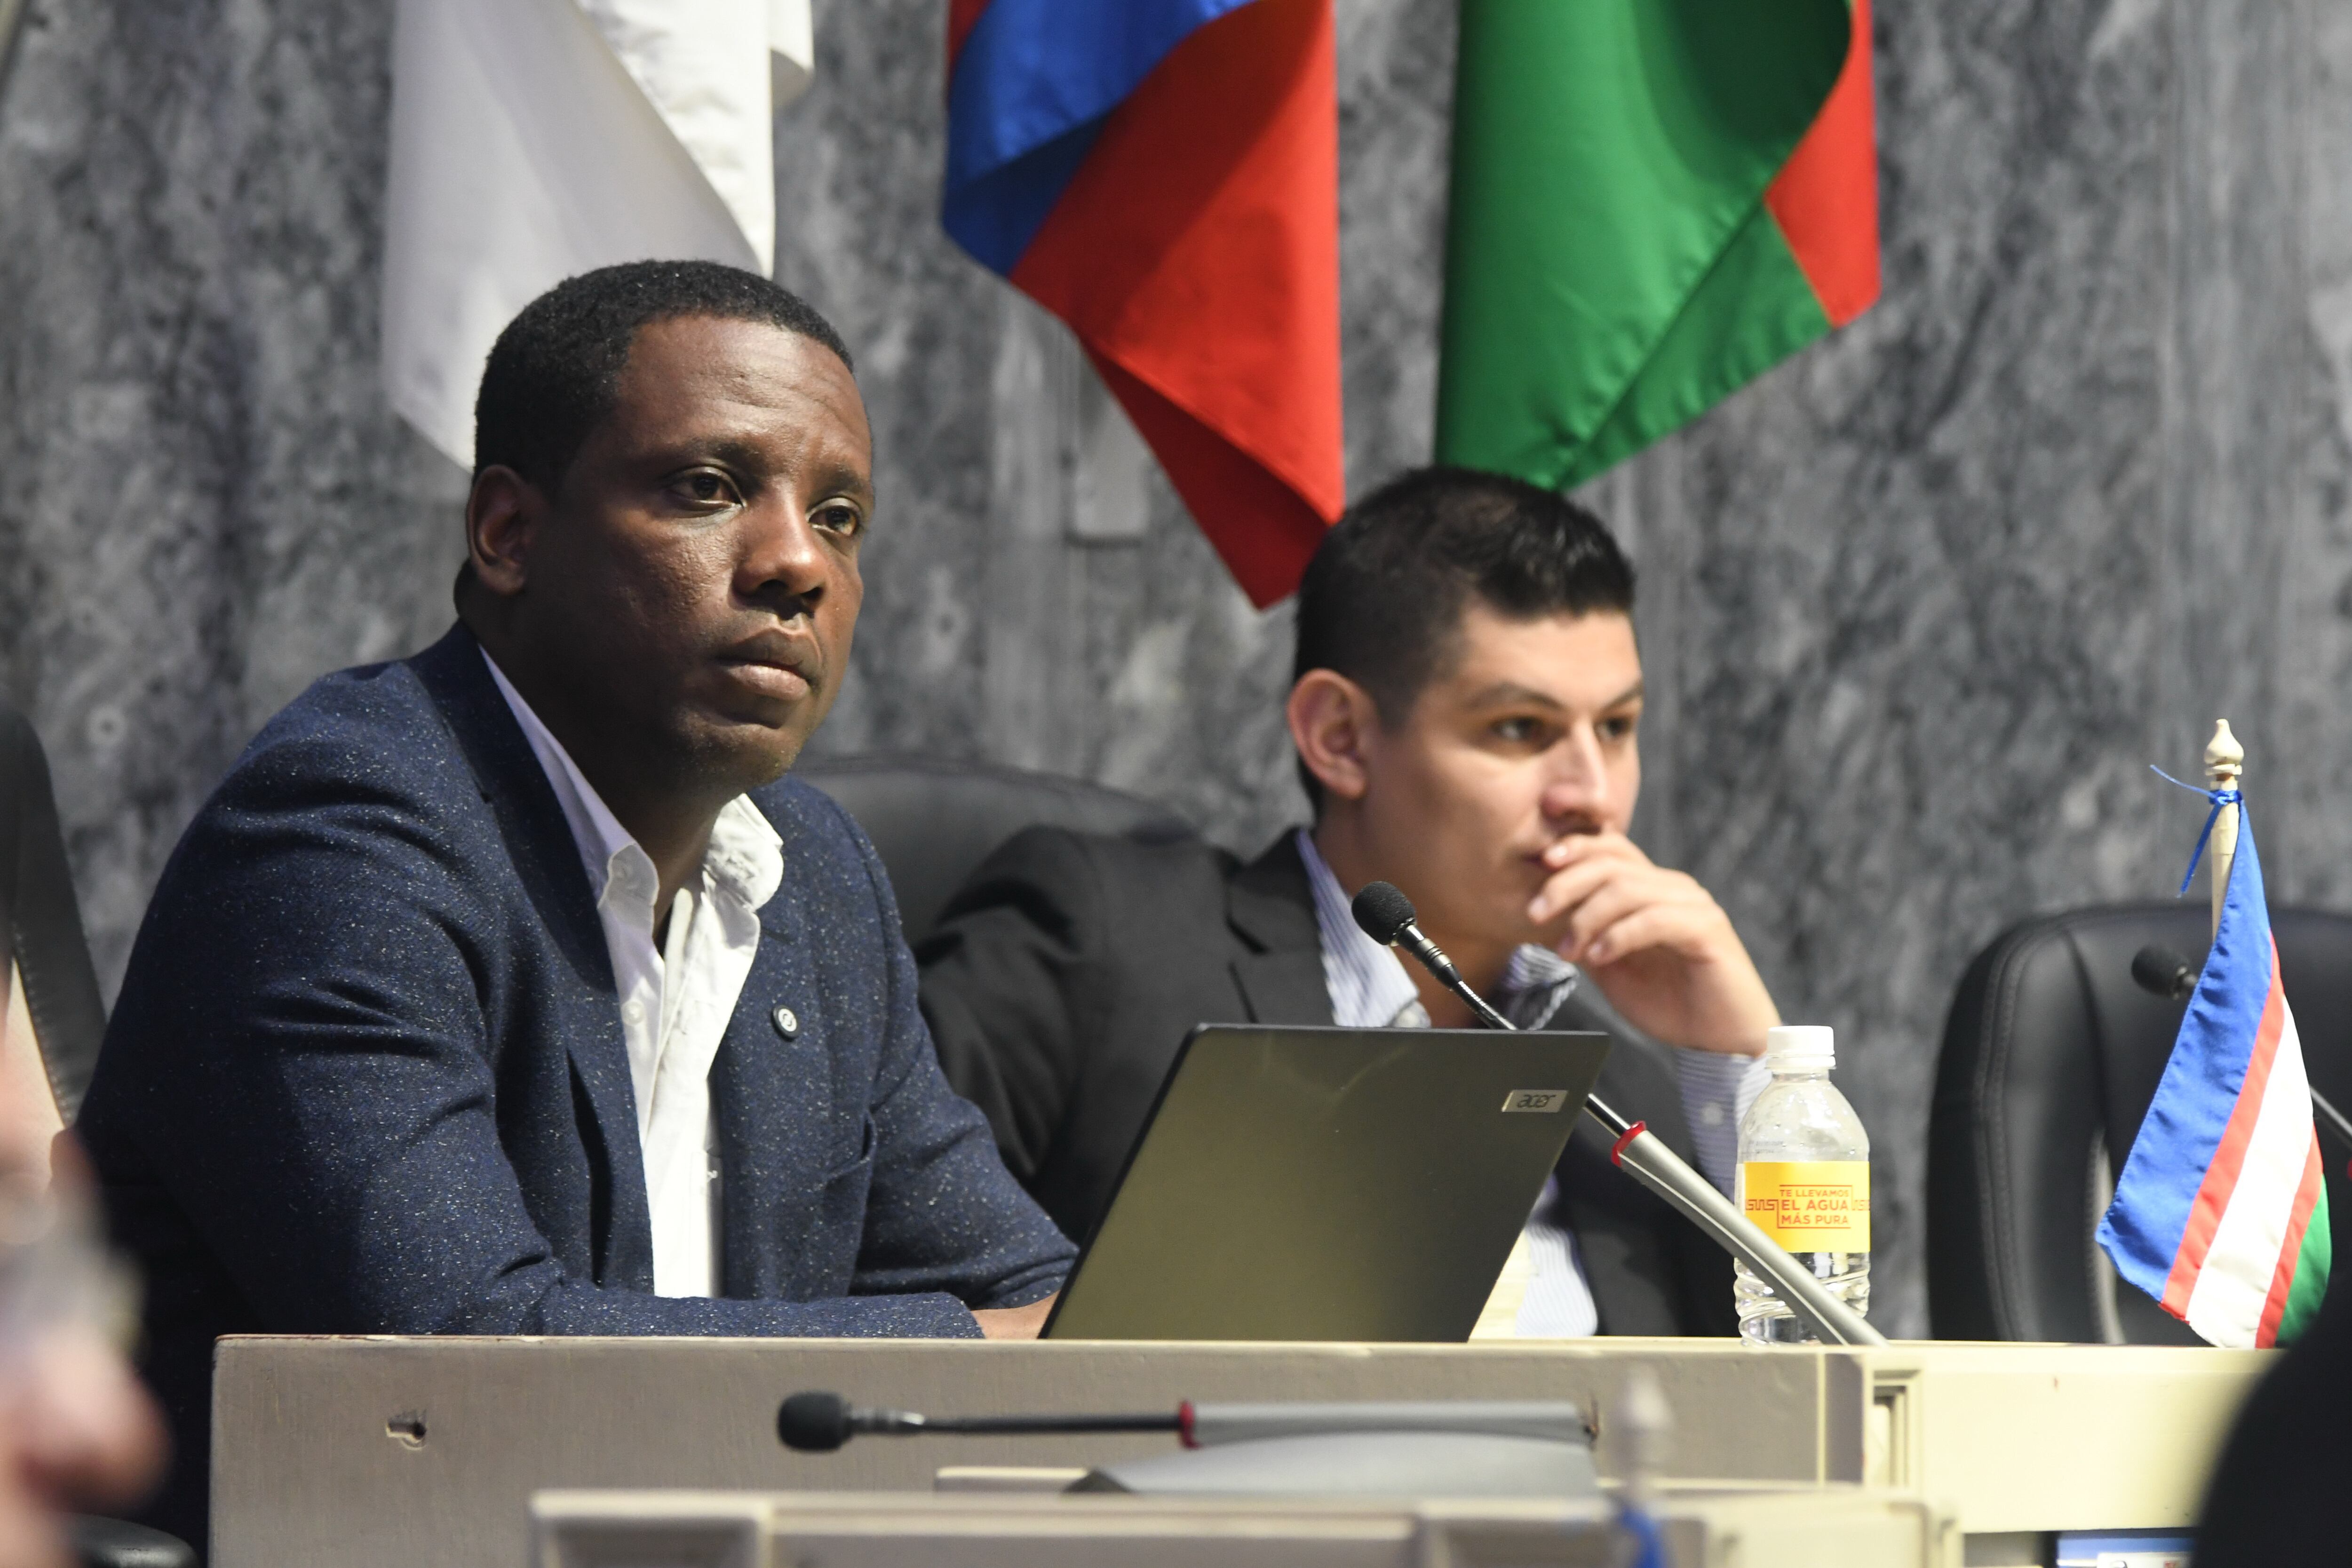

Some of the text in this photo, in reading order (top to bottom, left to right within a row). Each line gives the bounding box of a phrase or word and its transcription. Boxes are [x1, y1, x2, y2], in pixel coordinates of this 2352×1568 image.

[1517, 1094, 1556, 1108] acer
[1781, 1199, 1848, 1210] EL AGUA
[1781, 1212, 1849, 1224] MÁS PURA
